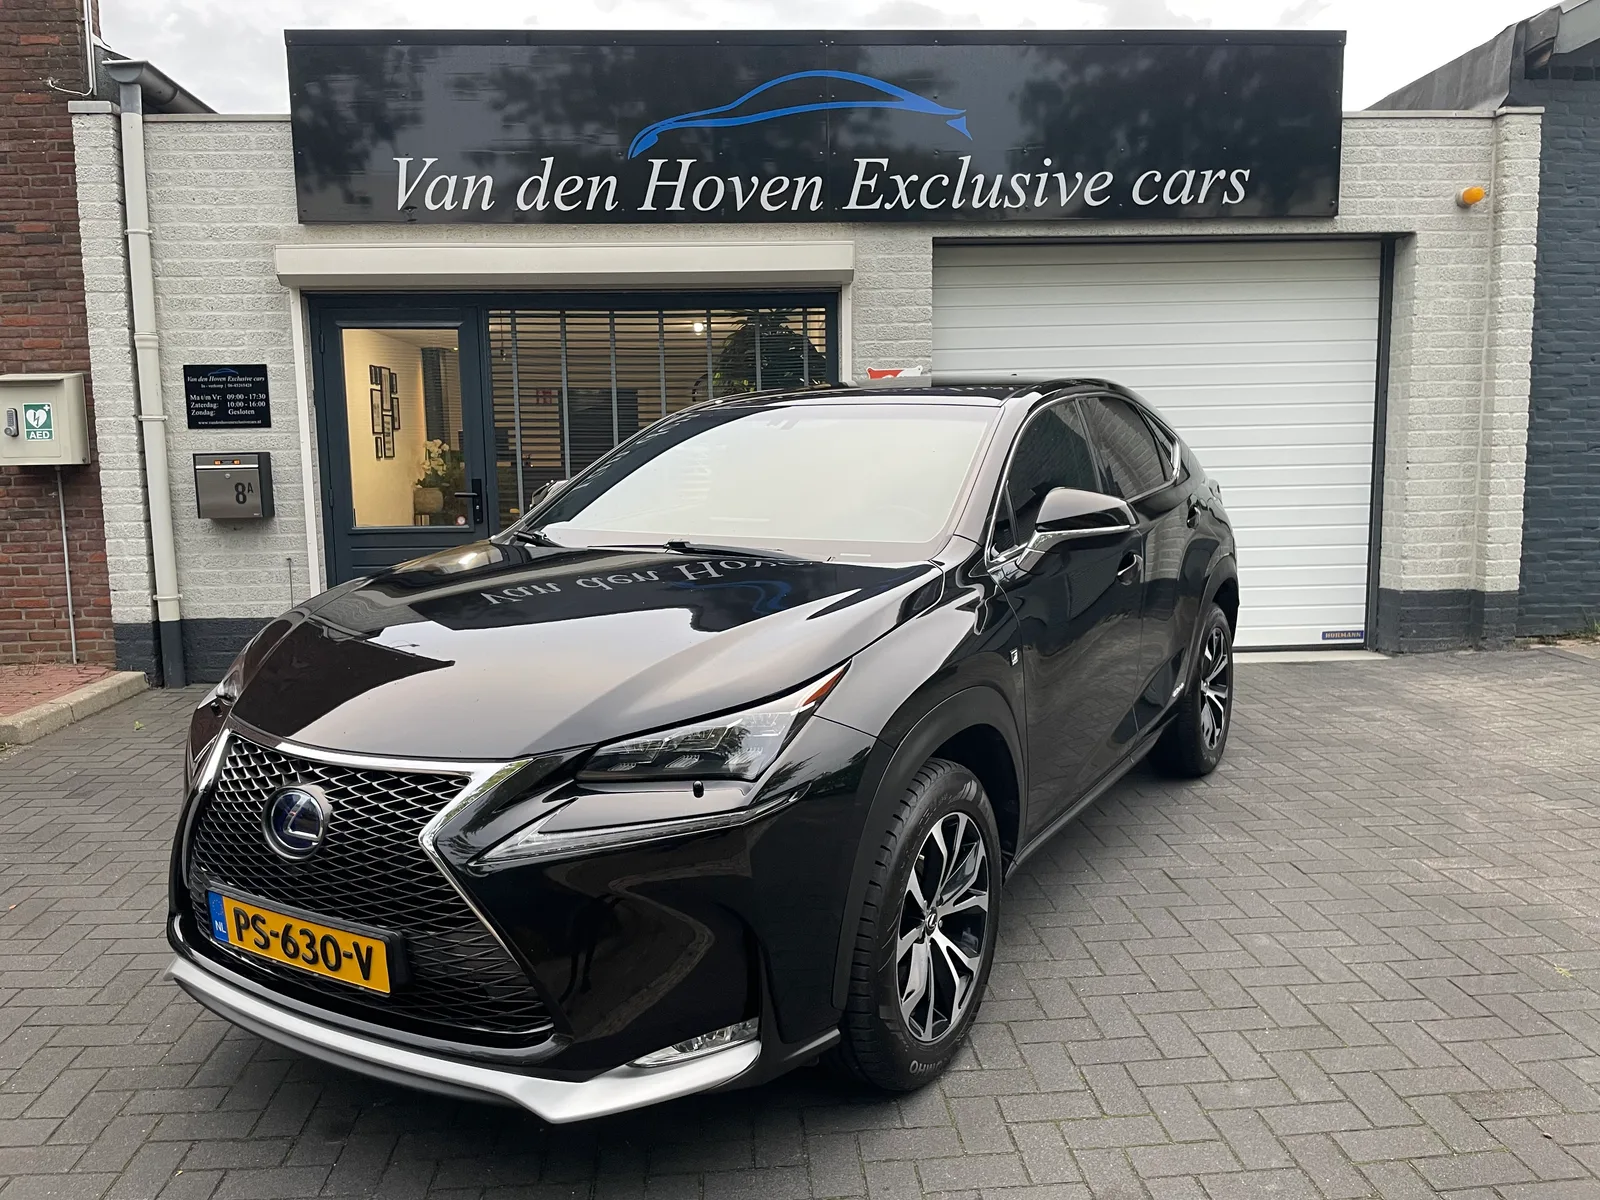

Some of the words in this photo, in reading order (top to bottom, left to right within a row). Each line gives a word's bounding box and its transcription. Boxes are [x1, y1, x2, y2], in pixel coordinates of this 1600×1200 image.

[392, 156, 496, 211] Van
[515, 156, 619, 211] den
[636, 158, 824, 212] Hoven
[842, 155, 1114, 210] Exclusive
[1131, 167, 1251, 206] cars
[191, 409, 216, 417] Zondag:
[30, 431, 50, 439] AED
[215, 919, 227, 934] NL
[232, 906, 373, 981] PS-630-V
